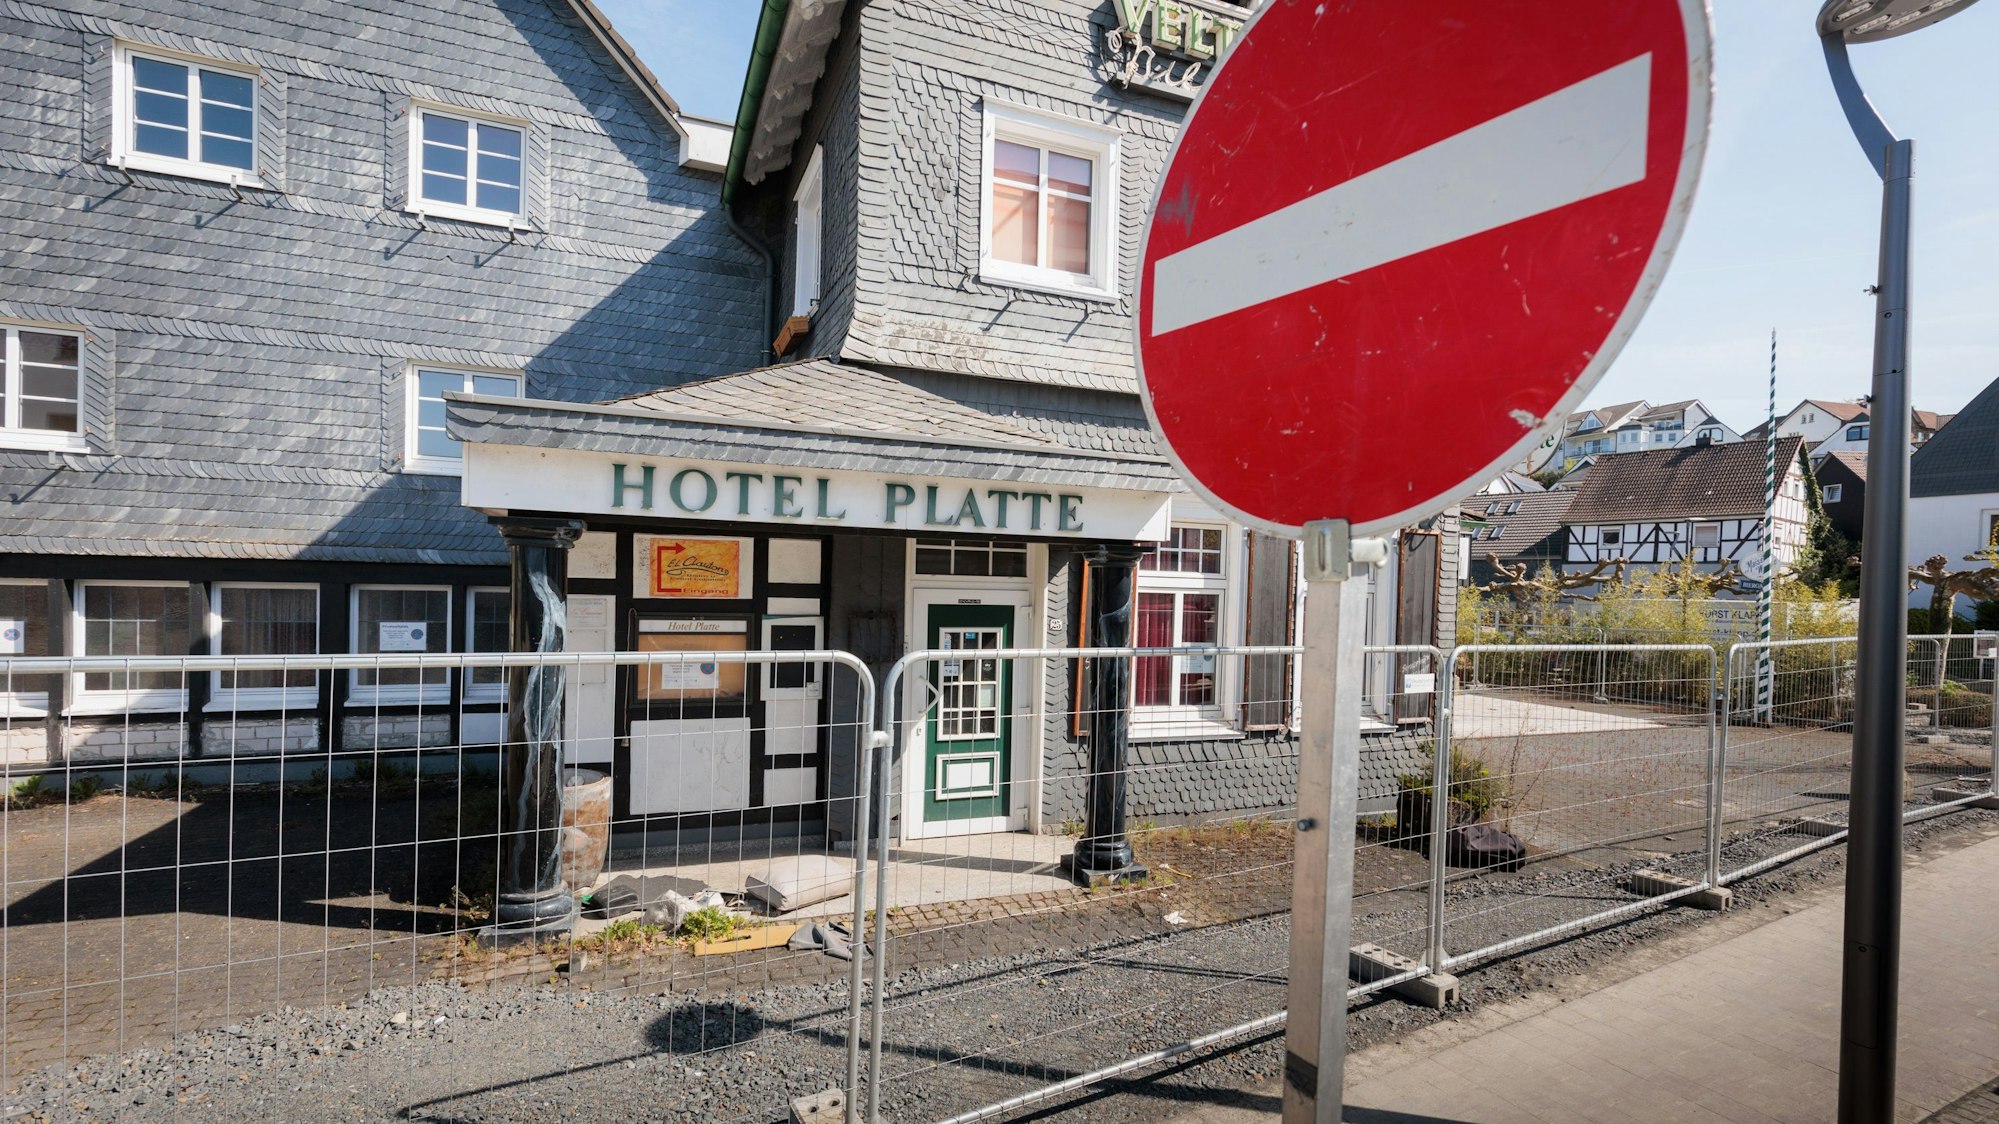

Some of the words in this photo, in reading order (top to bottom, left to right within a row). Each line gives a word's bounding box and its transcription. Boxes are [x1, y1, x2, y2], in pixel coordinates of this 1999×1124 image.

[611, 463, 847, 519] HOTEL
[885, 482, 1084, 532] PLATTE
[667, 621, 692, 631] Hotel
[694, 621, 721, 631] Platte
